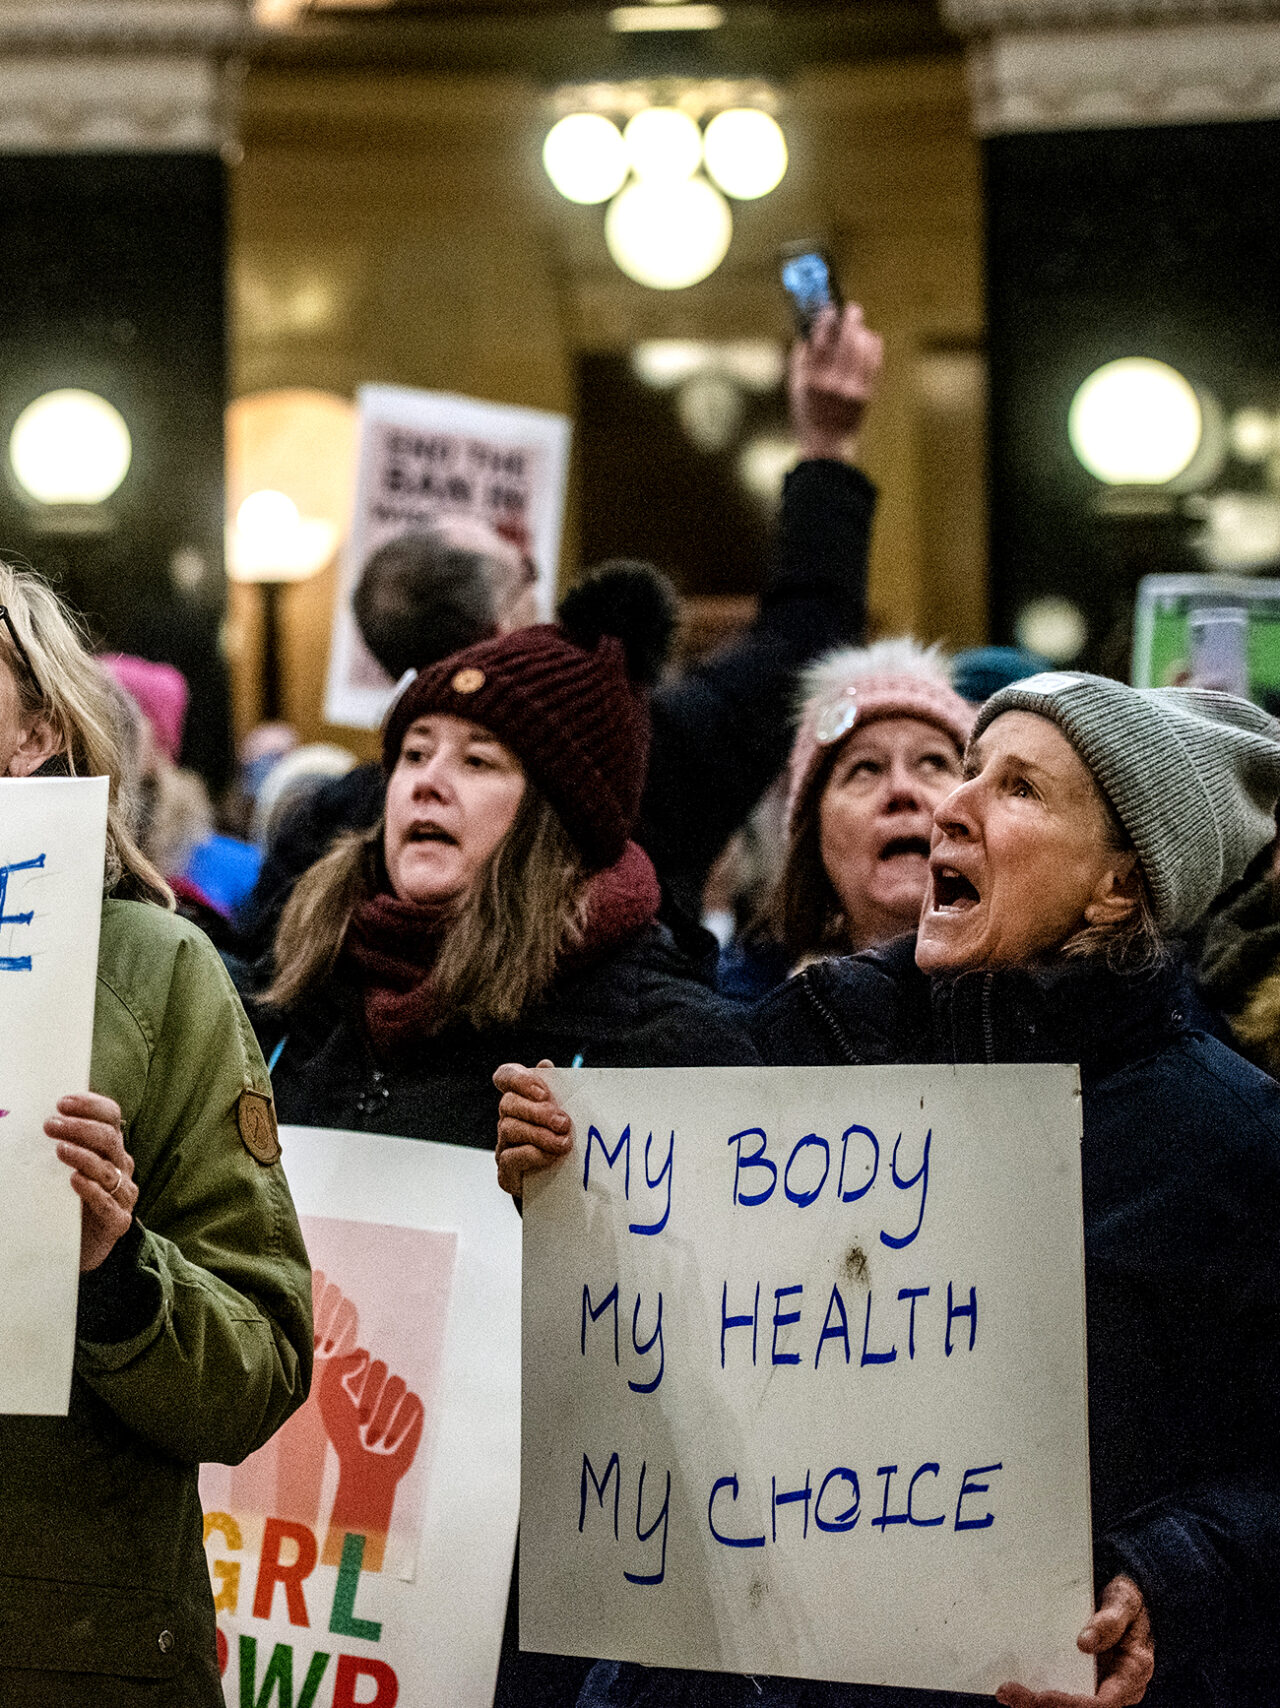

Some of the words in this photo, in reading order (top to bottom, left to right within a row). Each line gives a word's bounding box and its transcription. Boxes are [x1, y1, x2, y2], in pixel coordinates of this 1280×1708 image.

[728, 1124, 932, 1249] BODY
[720, 1281, 978, 1369] HEALTH
[708, 1462, 1003, 1548] CHOICE
[203, 1511, 382, 1642] GRL
